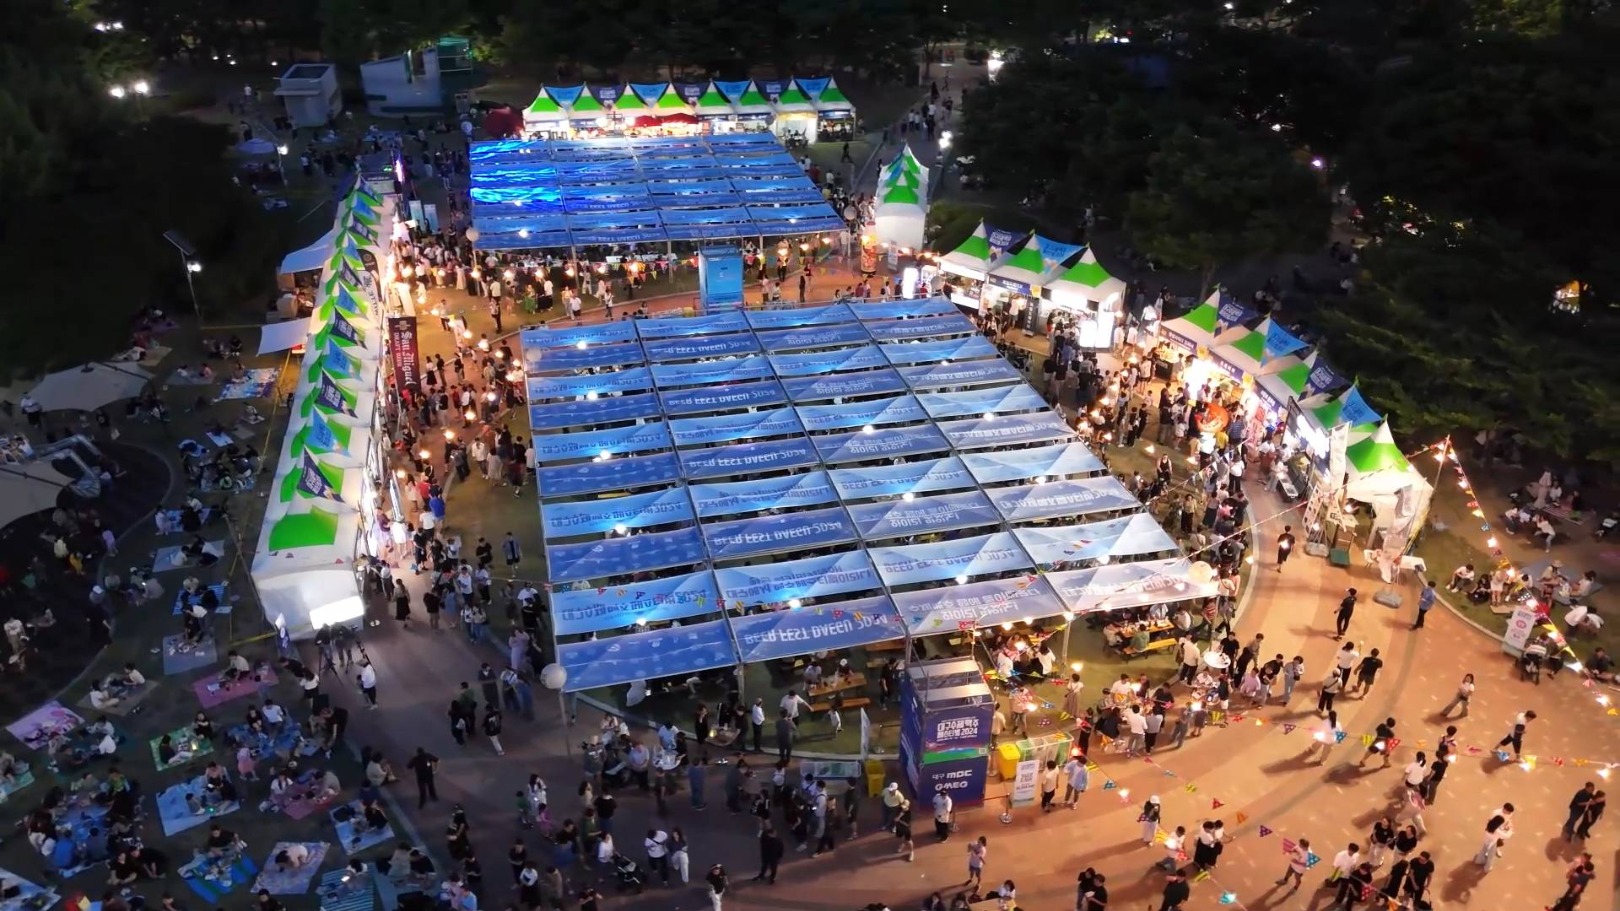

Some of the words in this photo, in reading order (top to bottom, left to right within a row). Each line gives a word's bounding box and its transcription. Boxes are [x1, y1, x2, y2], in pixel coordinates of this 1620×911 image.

[393, 332, 401, 351] DRAFT
[401, 331, 413, 351] San
[402, 352, 418, 385] Miguel
[960, 727, 978, 737] 2024
